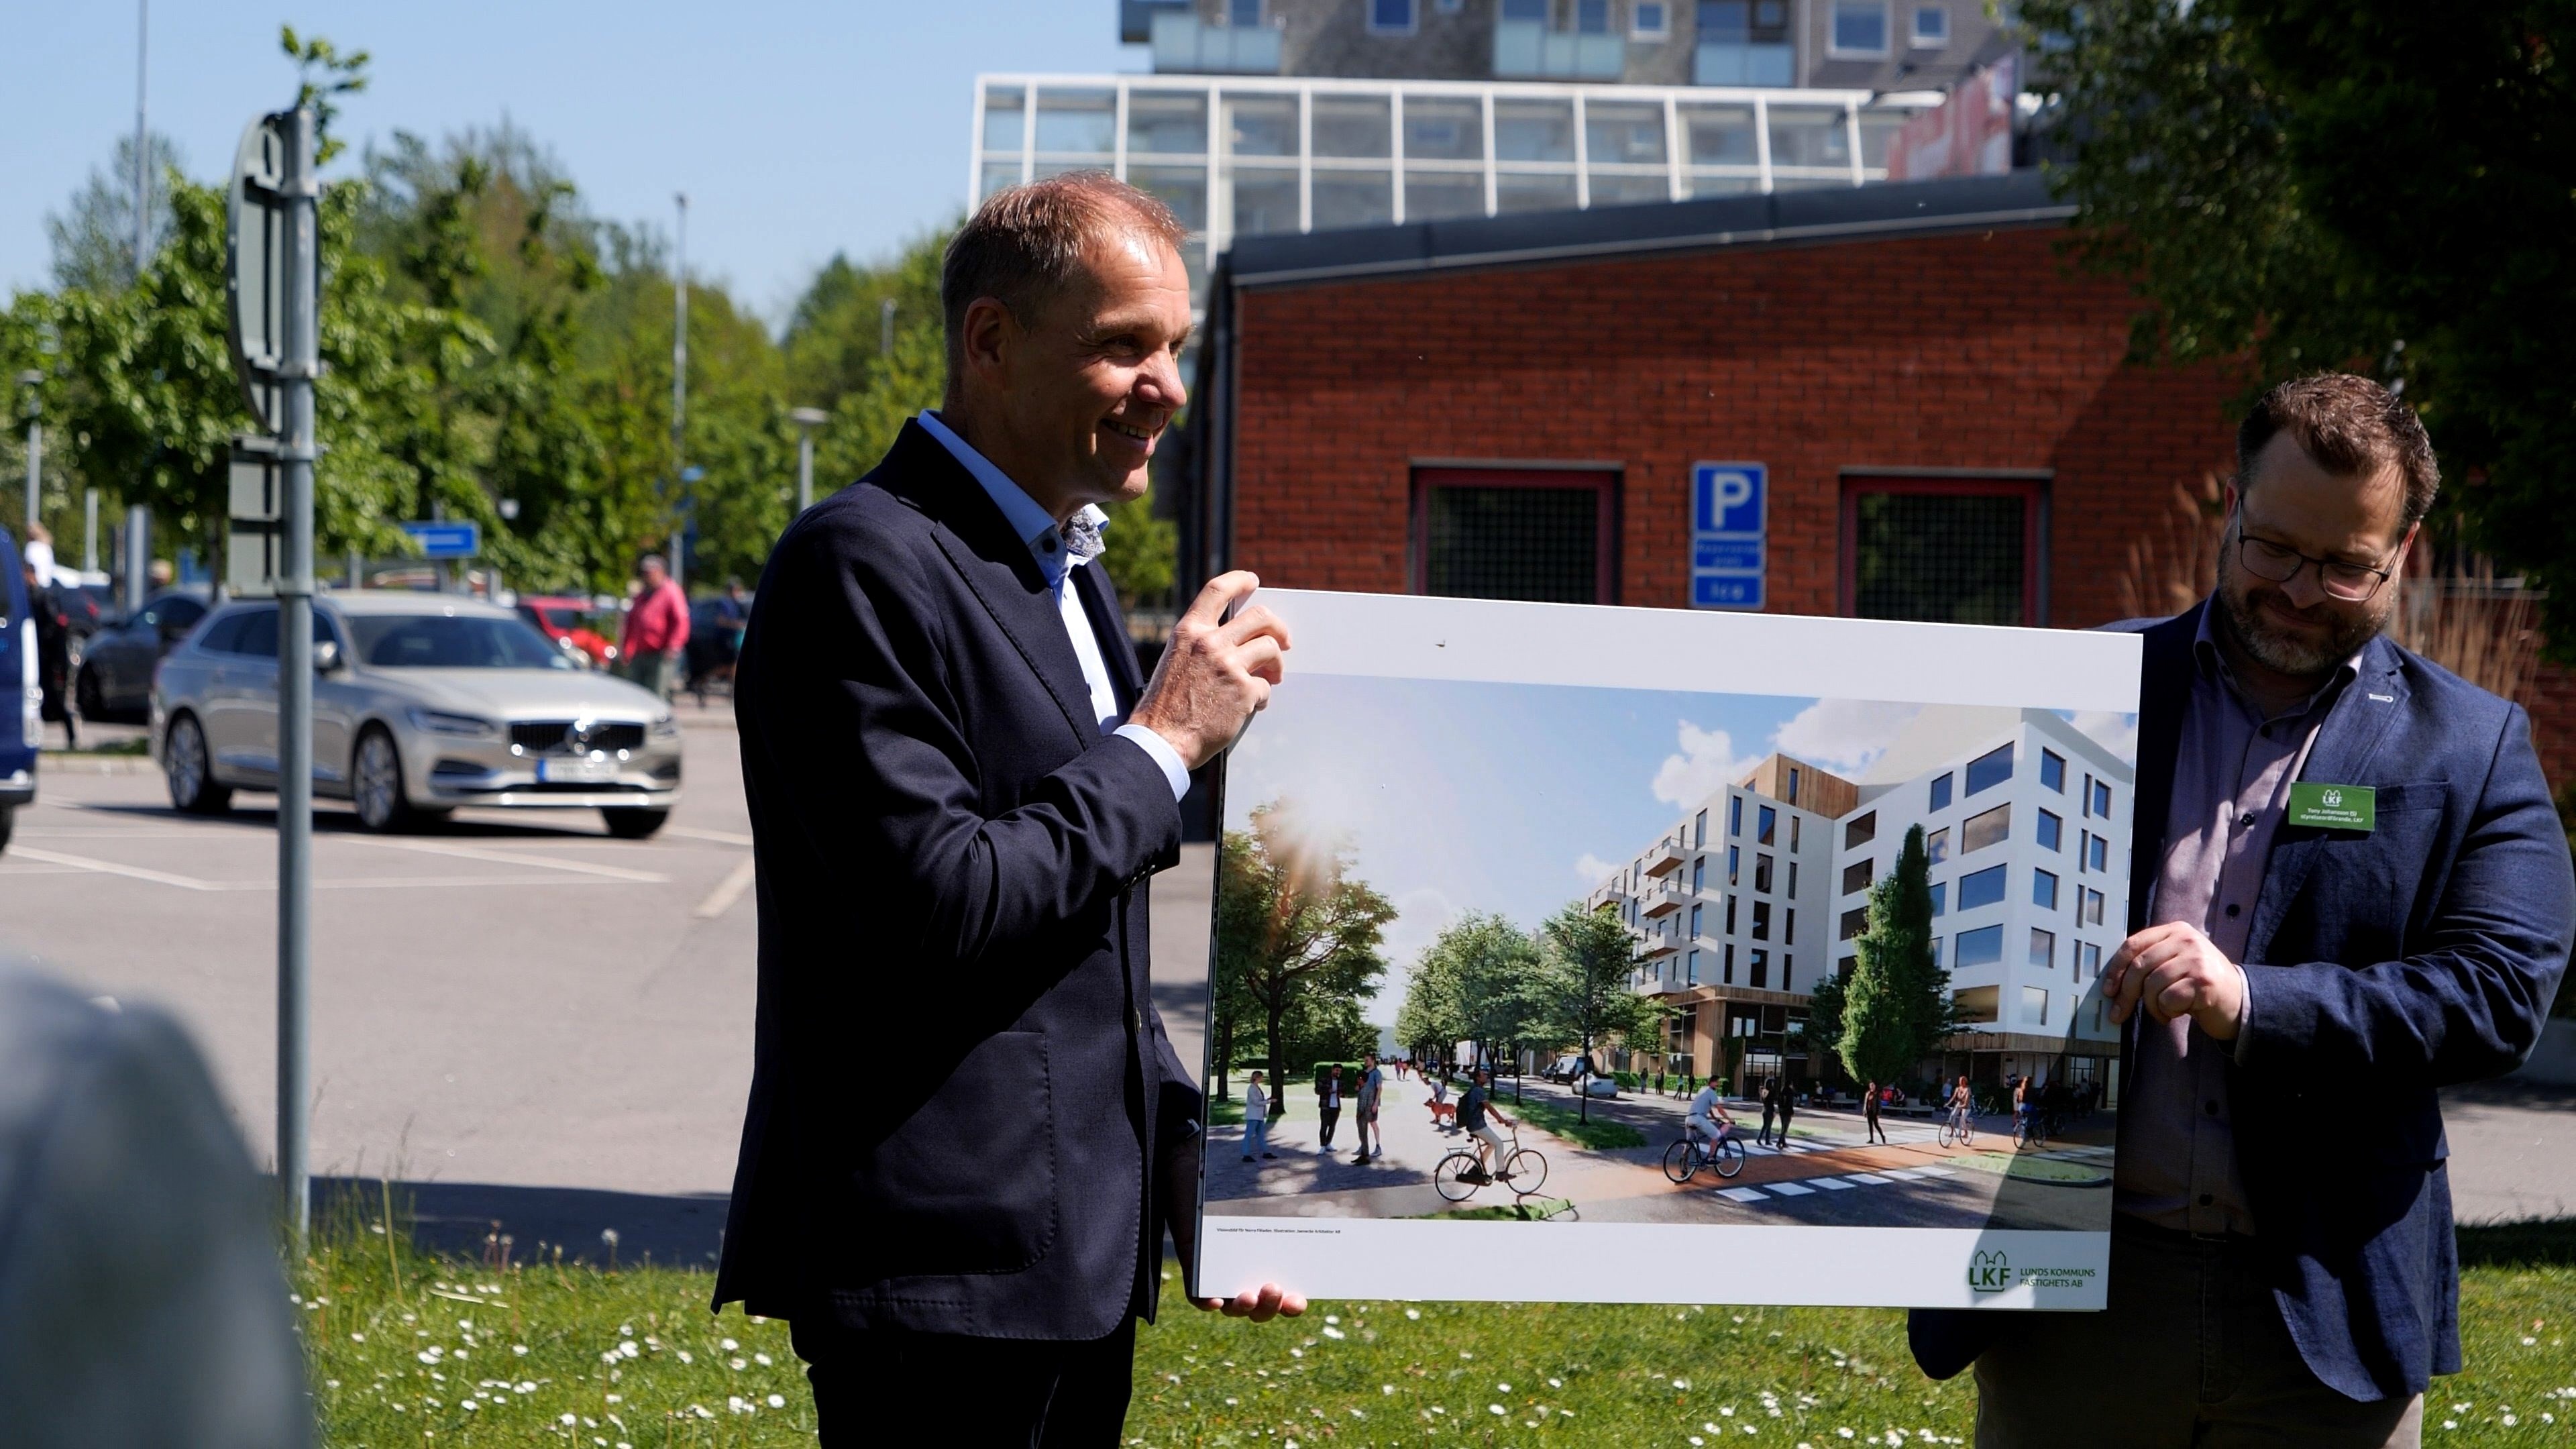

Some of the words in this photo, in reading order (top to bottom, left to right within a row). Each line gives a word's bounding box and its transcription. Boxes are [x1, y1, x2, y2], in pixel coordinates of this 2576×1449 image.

[1712, 472, 1753, 529] P
[2322, 796, 2343, 804] LKF
[1969, 1267, 2010, 1286] LKF
[2021, 1268, 2049, 1277] LUNDS
[2050, 1269, 2096, 1277] KOMMUNS
[2020, 1279, 2070, 1287] FASTIGHETS
[2071, 1279, 2083, 1287] AB
